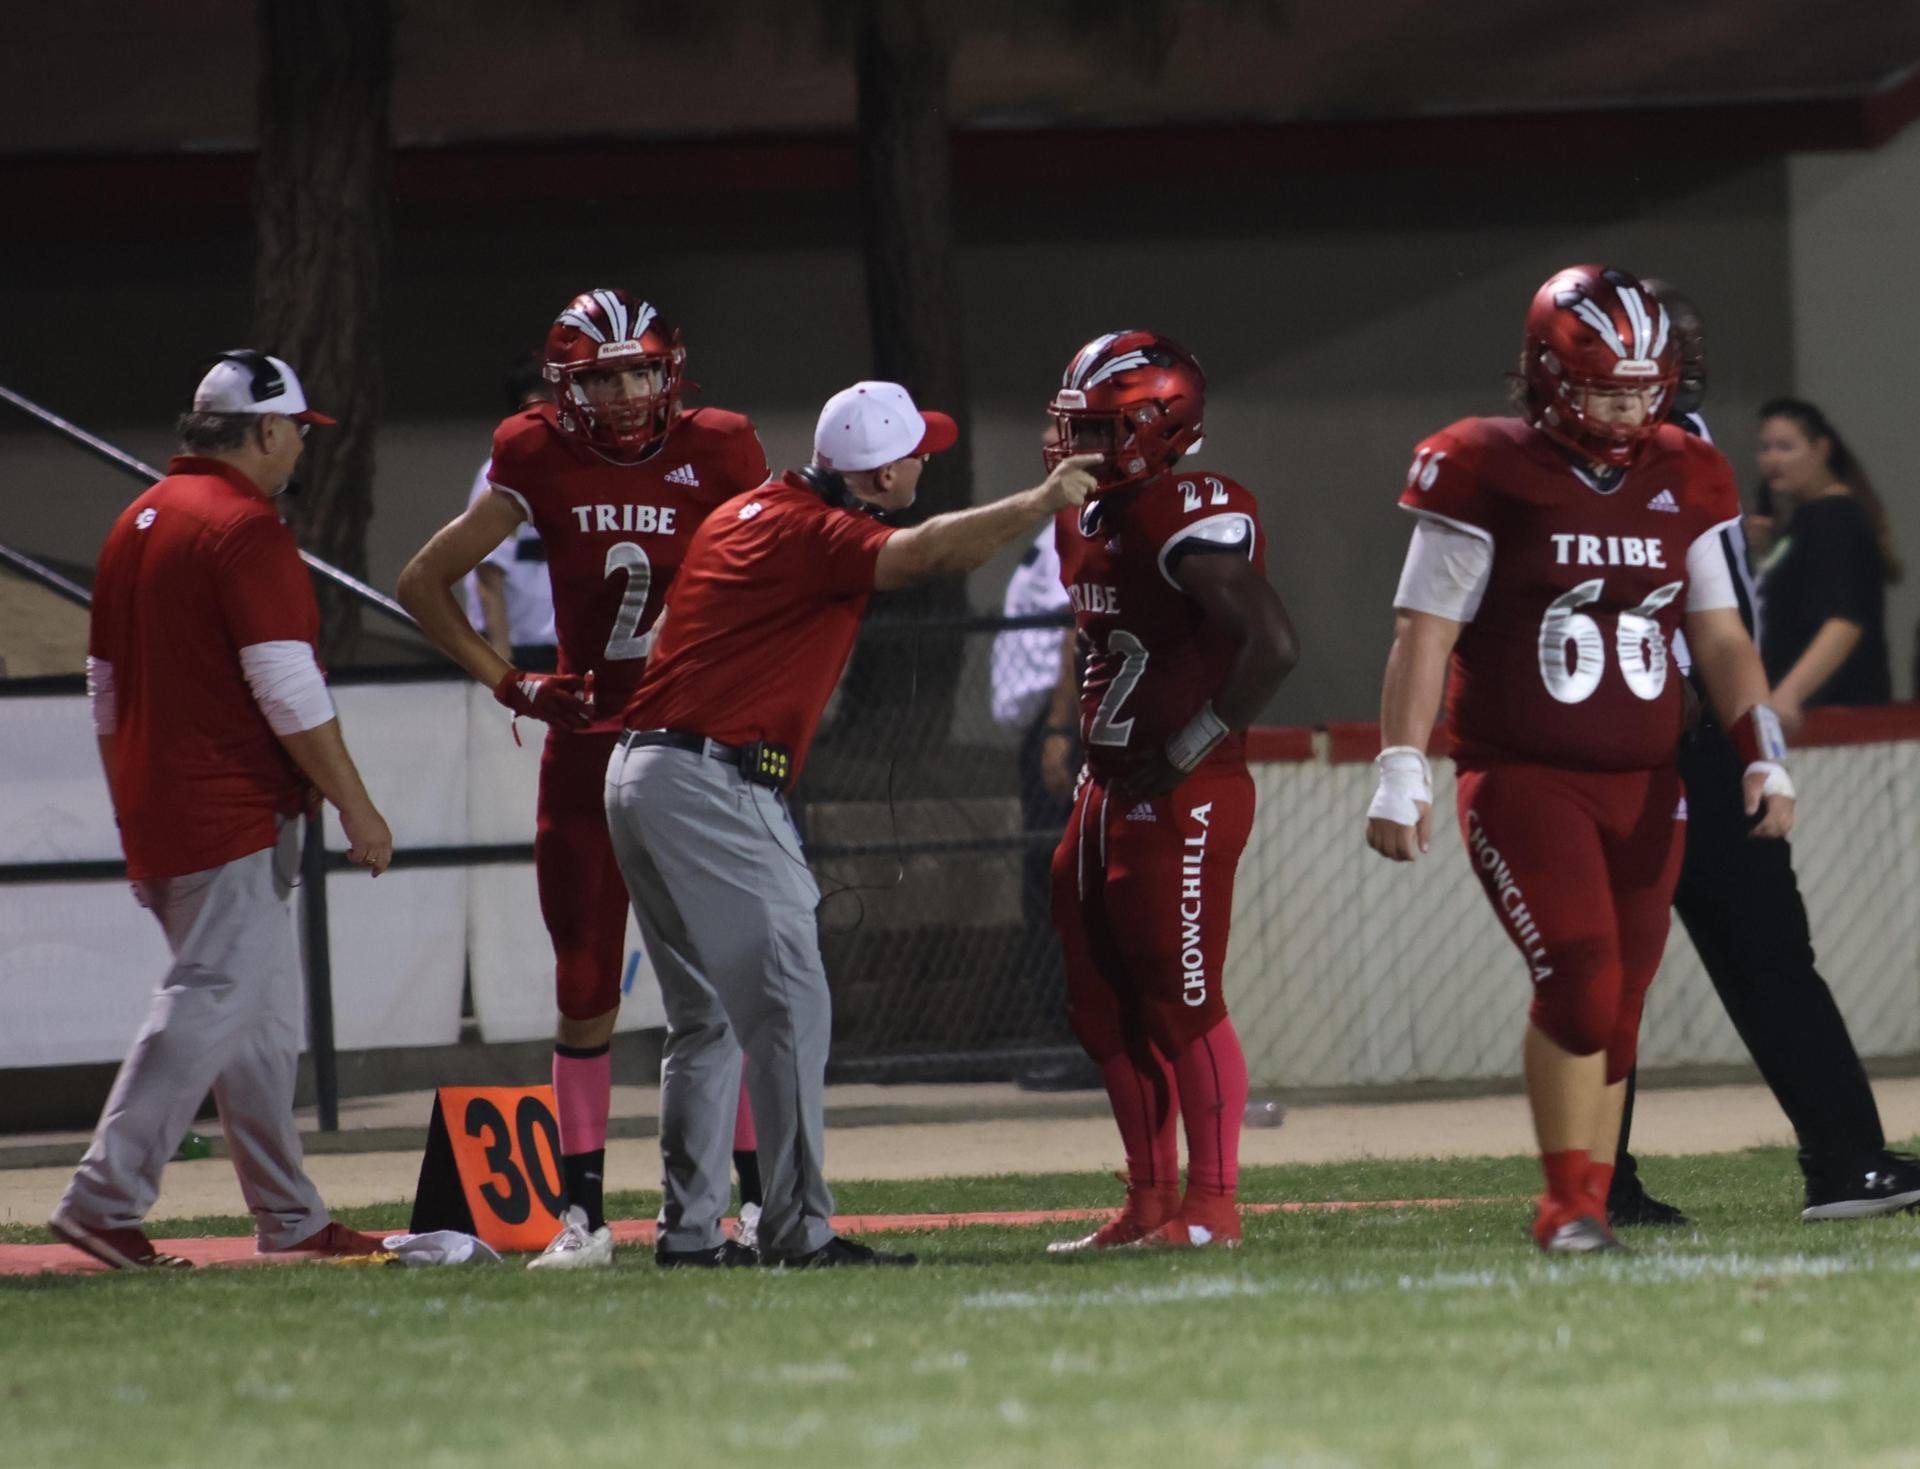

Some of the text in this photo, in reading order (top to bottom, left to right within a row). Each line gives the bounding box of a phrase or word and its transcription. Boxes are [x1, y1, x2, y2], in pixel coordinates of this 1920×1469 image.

[664, 474, 700, 488] adidas
[1407, 447, 1446, 491] 66
[1177, 477, 1229, 513] 22
[571, 504, 676, 535] TRIBE
[1551, 534, 1667, 569] TRIBE
[604, 541, 651, 661] 2
[1067, 583, 1121, 614] RIBE
[1538, 578, 1683, 704] 66
[1181, 801, 1212, 1007] CHOWCHILLA
[465, 1095, 569, 1226] 30
